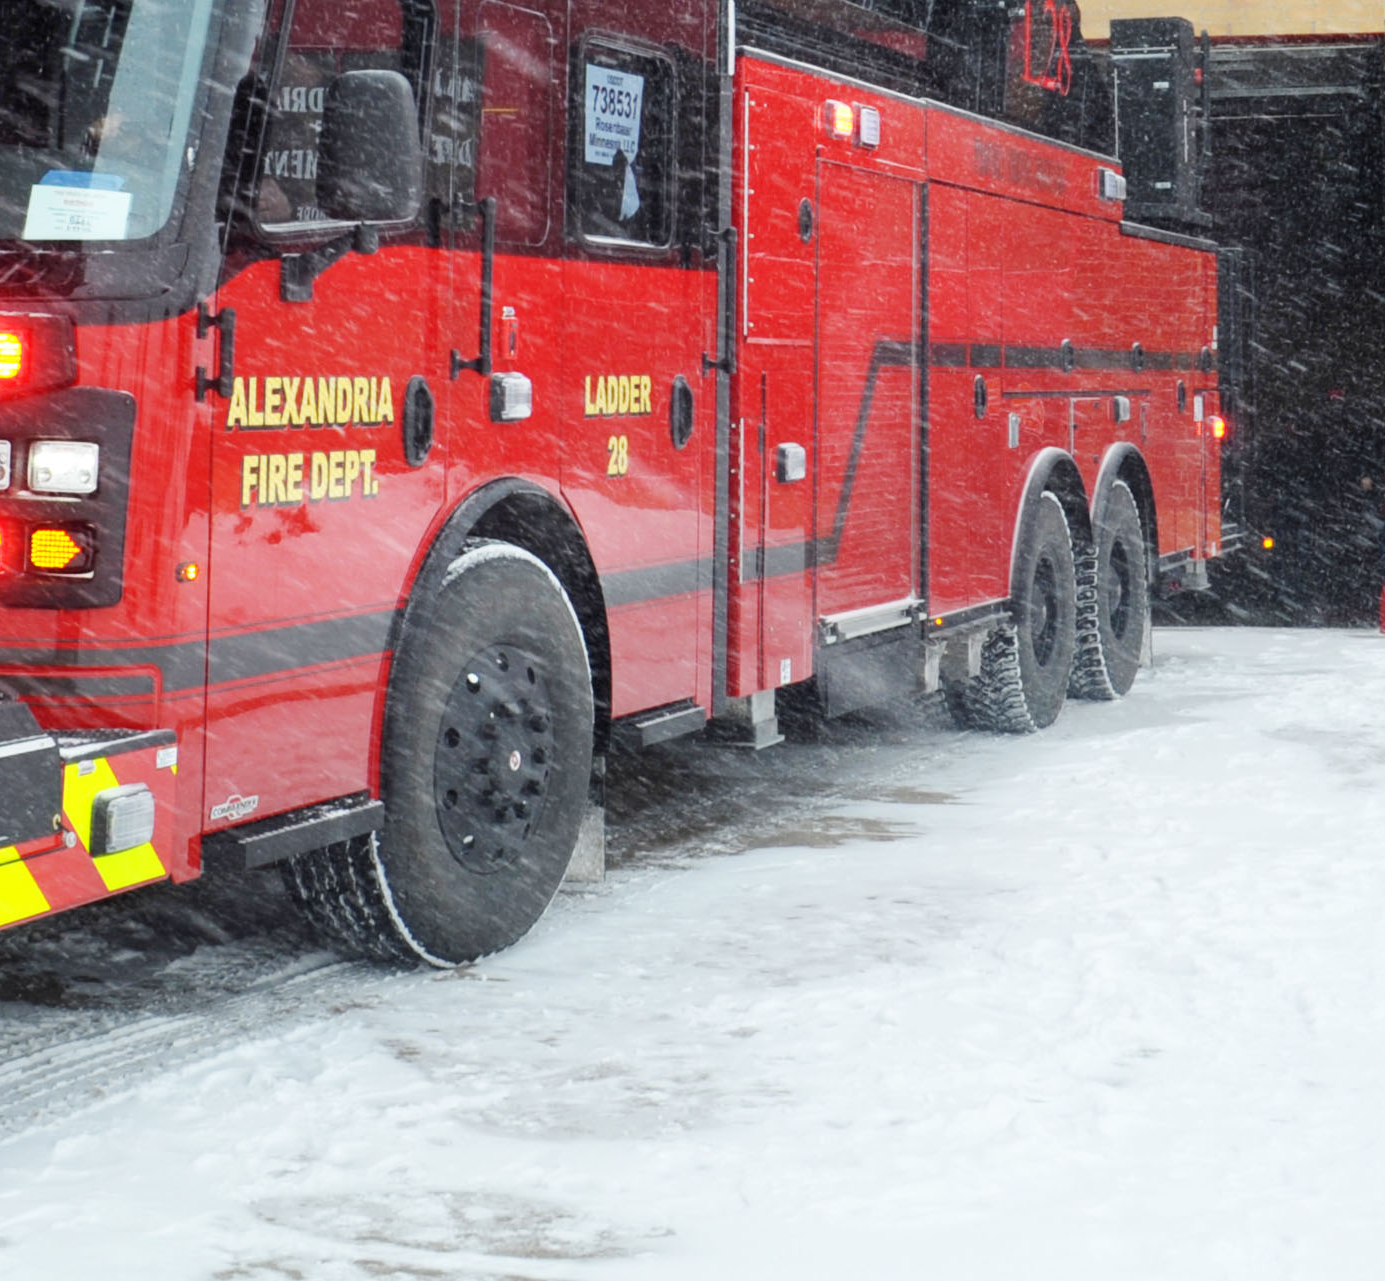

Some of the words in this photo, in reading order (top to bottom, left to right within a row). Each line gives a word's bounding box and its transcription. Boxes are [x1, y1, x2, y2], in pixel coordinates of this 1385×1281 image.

[592, 84, 639, 120] 738531
[226, 376, 395, 431] ALEXANDRIA
[584, 375, 652, 418] LADDER
[606, 434, 629, 478] 28
[241, 452, 304, 509] FIRE
[309, 449, 380, 503] DEPT.
